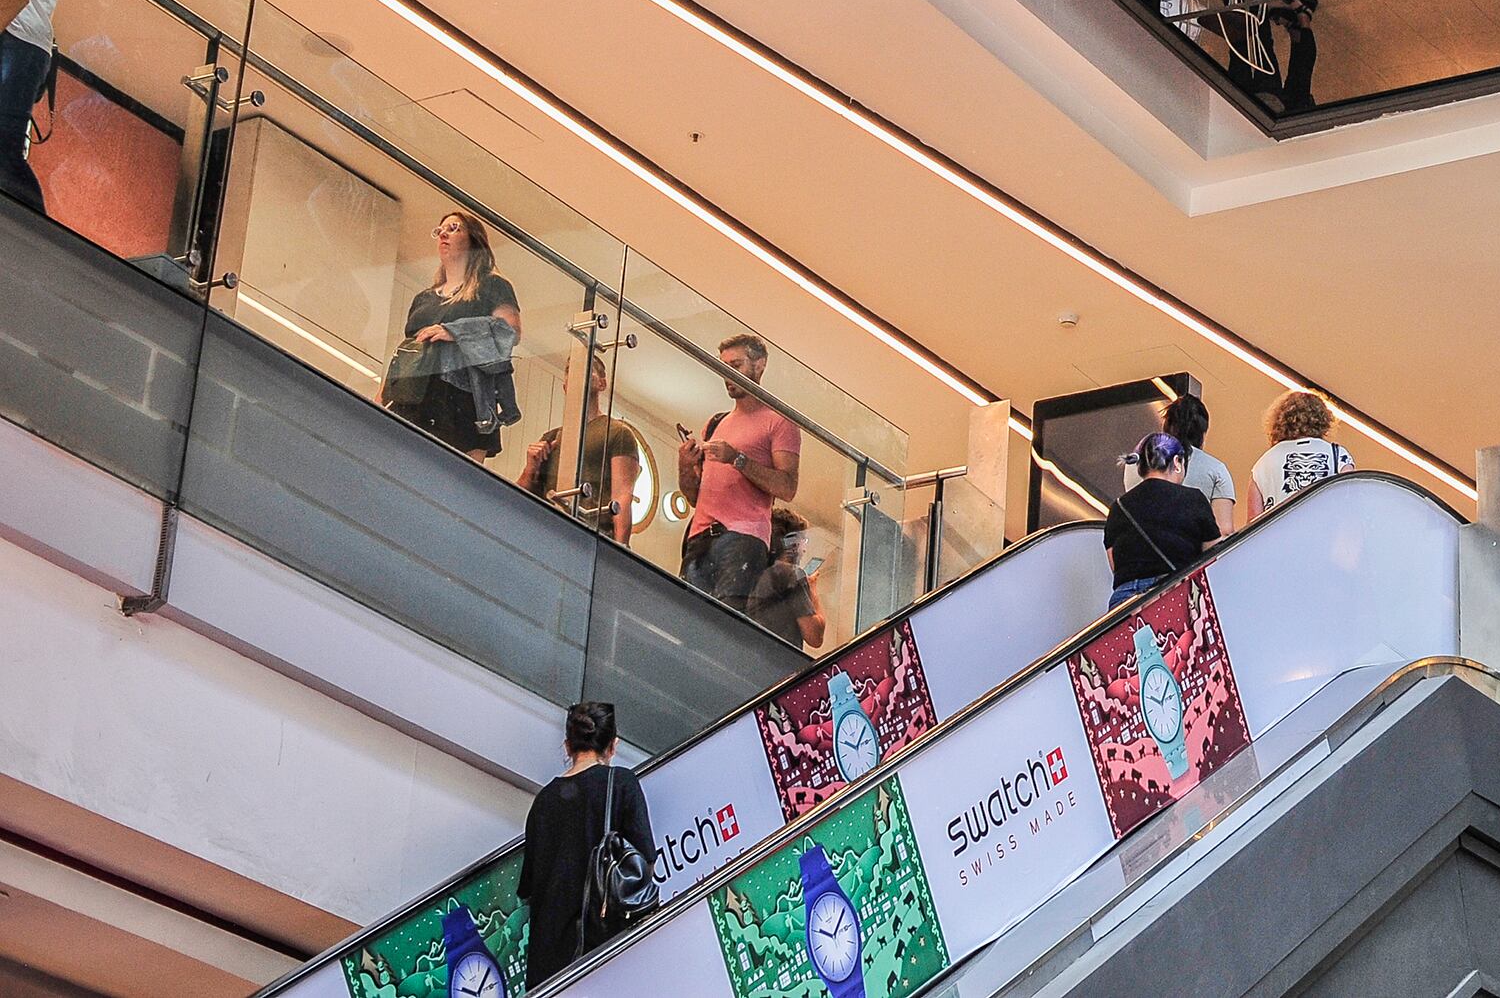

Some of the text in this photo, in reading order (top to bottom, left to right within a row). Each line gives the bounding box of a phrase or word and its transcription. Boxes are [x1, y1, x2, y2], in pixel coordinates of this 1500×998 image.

[652, 815, 721, 884] atch
[947, 758, 1051, 858] swatch
[958, 790, 1077, 887] SWISS MADE
